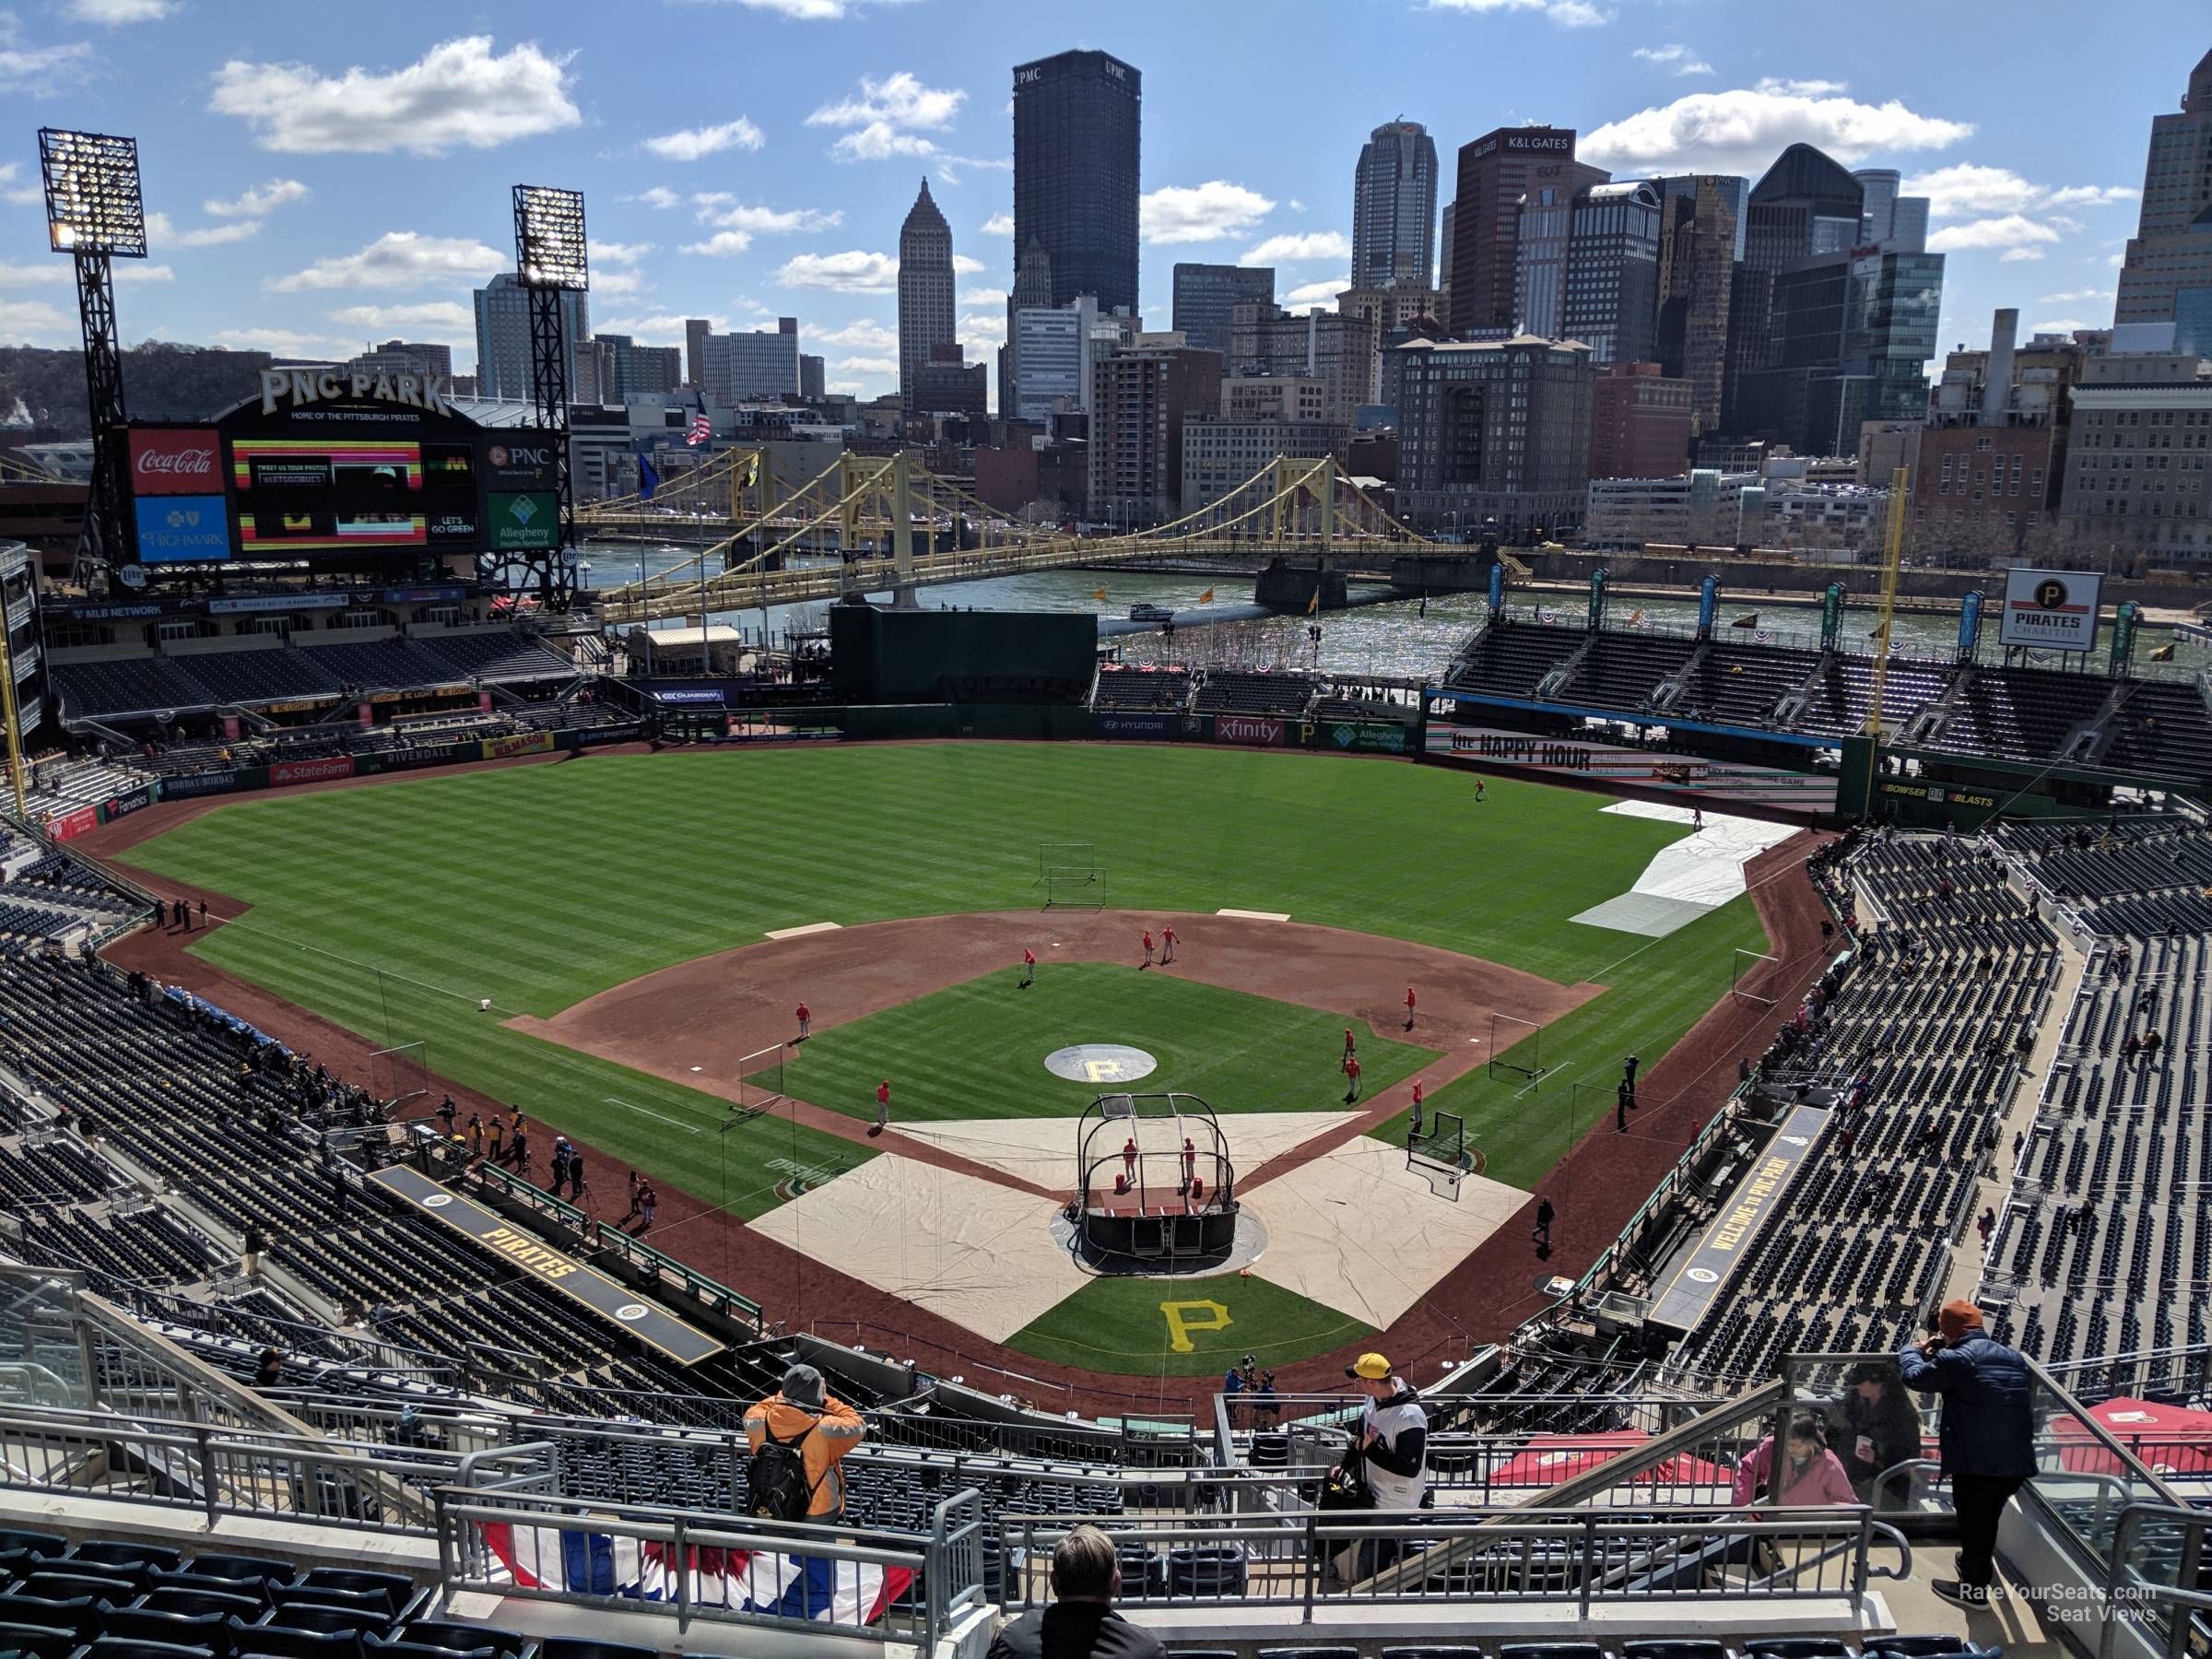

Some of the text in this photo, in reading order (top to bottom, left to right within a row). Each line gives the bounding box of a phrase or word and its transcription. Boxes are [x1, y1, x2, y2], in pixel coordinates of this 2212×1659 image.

[1105, 60, 1126, 82] UPMC
[1509, 137, 1568, 149] K&L GATES
[259, 369, 453, 418] PNC PARK
[291, 411, 420, 422] HOME OF THE PITTSBURGH PIRATES
[138, 449, 214, 474] Coca-Cola
[511, 448, 551, 465] PNC
[442, 516, 464, 524] LET'S
[431, 524, 475, 534] GO GREEN
[500, 527, 549, 539] Allegheny
[124, 570, 145, 581] Lite
[2045, 586, 2059, 605] P
[86, 606, 162, 619] MLB NETWORK
[2016, 613, 2081, 629] PIRATES
[2014, 626, 2080, 638] CHARITIES
[1121, 722, 1164, 731] HYUNDAI
[1220, 720, 1280, 742] xfinity
[1300, 724, 1315, 743] P
[1359, 729, 1406, 742] Allegheny
[387, 747, 453, 764] RIVENDALE
[1480, 734, 1537, 762] HAPPY
[1542, 742, 1592, 771] HOUR
[1887, 784, 1927, 797] BOWSER
[1954, 794, 1994, 807] BLASTS
[118, 794, 148, 815] Fanatics
[1711, 1156, 1792, 1251] WELCOME TO PNC PARK
[482, 1228, 579, 1279] PIRATES
[1160, 1300, 1234, 1353] P
